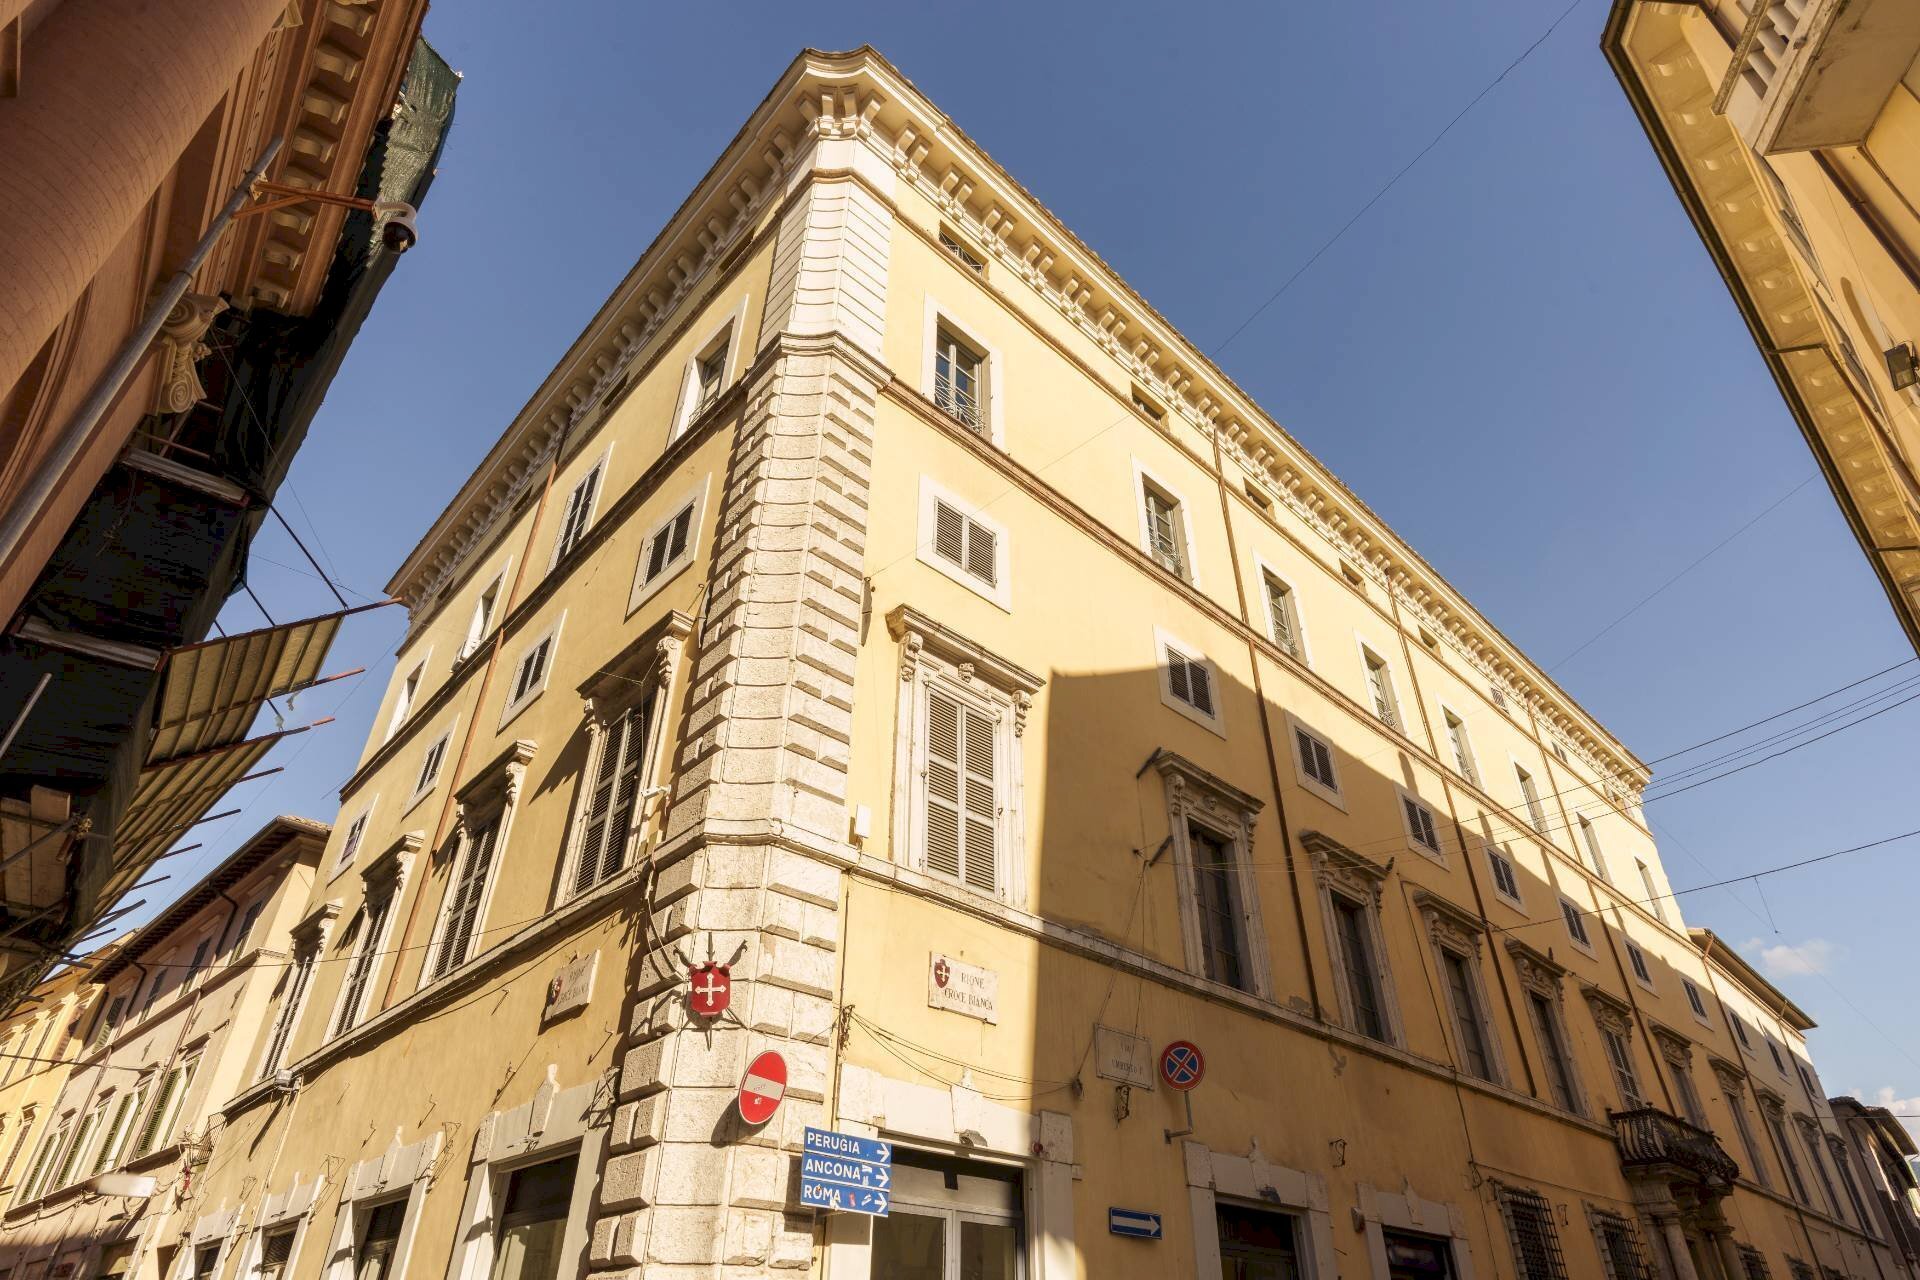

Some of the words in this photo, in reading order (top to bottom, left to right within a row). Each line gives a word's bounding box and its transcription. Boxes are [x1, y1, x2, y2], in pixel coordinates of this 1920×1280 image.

[961, 972, 985, 989] RIONE
[944, 987, 967, 1003] CROCE
[968, 993, 993, 1011] BIANCA
[807, 1131, 860, 1155] PERUGIA
[805, 1158, 861, 1181] ANCONA
[803, 1184, 841, 1203] ROMA
